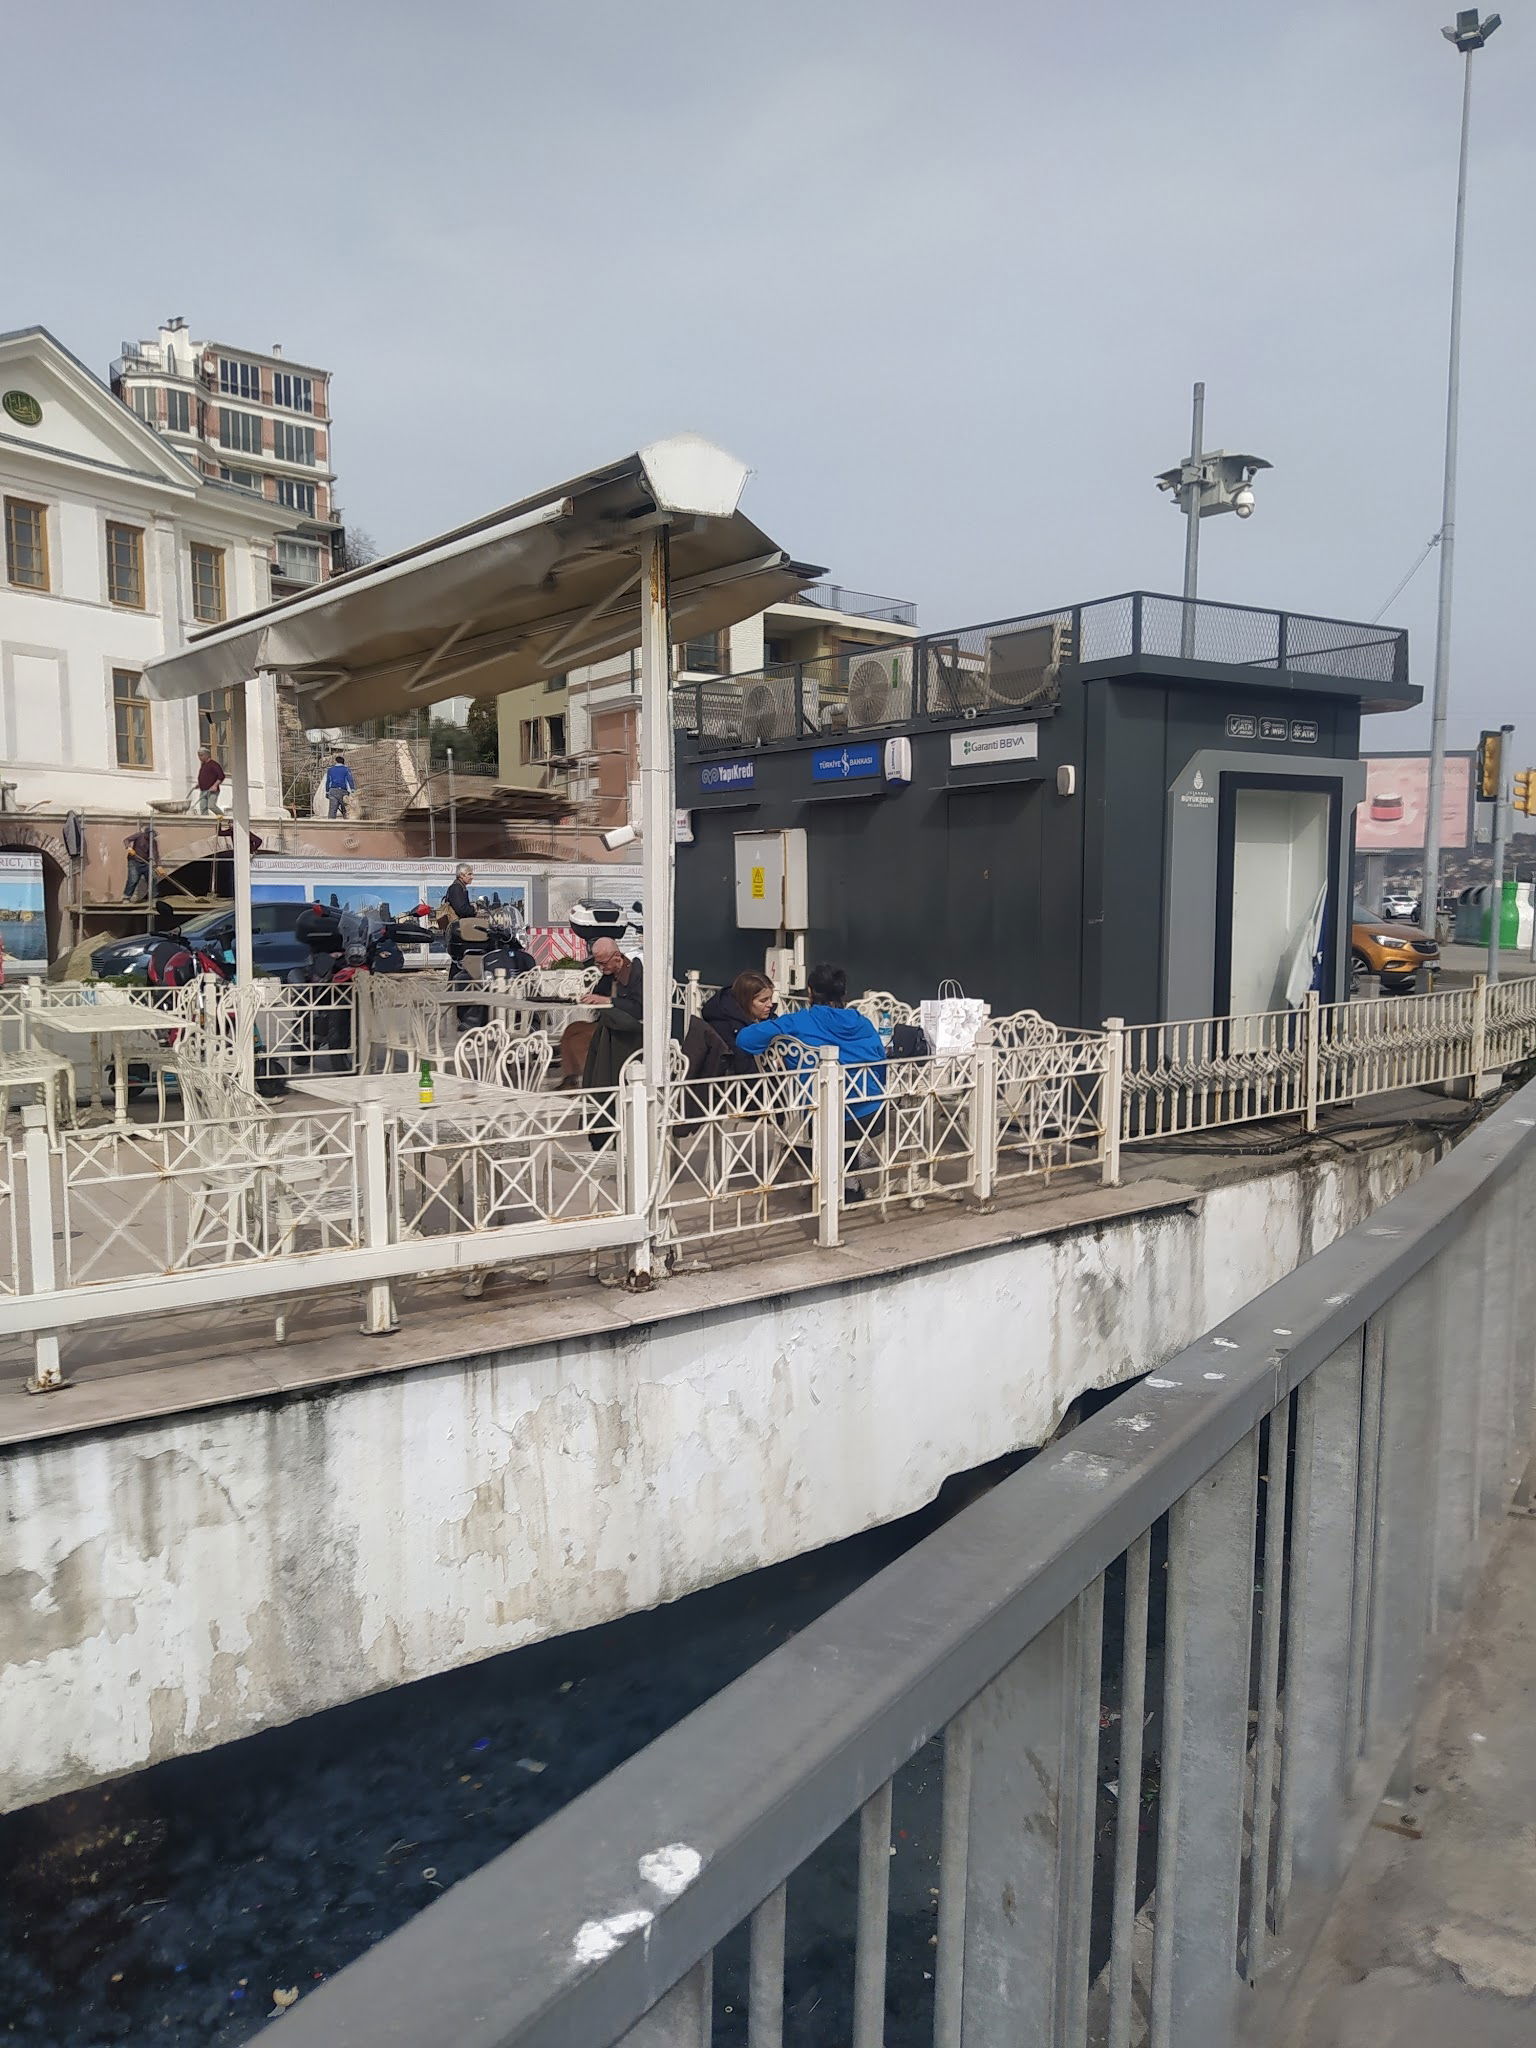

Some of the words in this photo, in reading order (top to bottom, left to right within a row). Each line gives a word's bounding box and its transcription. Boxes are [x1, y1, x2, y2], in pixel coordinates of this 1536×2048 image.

[971, 740, 999, 752] Garanti
[1000, 736, 1025, 749] BBVA
[819, 760, 842, 770] TÜRKİYE
[849, 757, 873, 766] BANKASI
